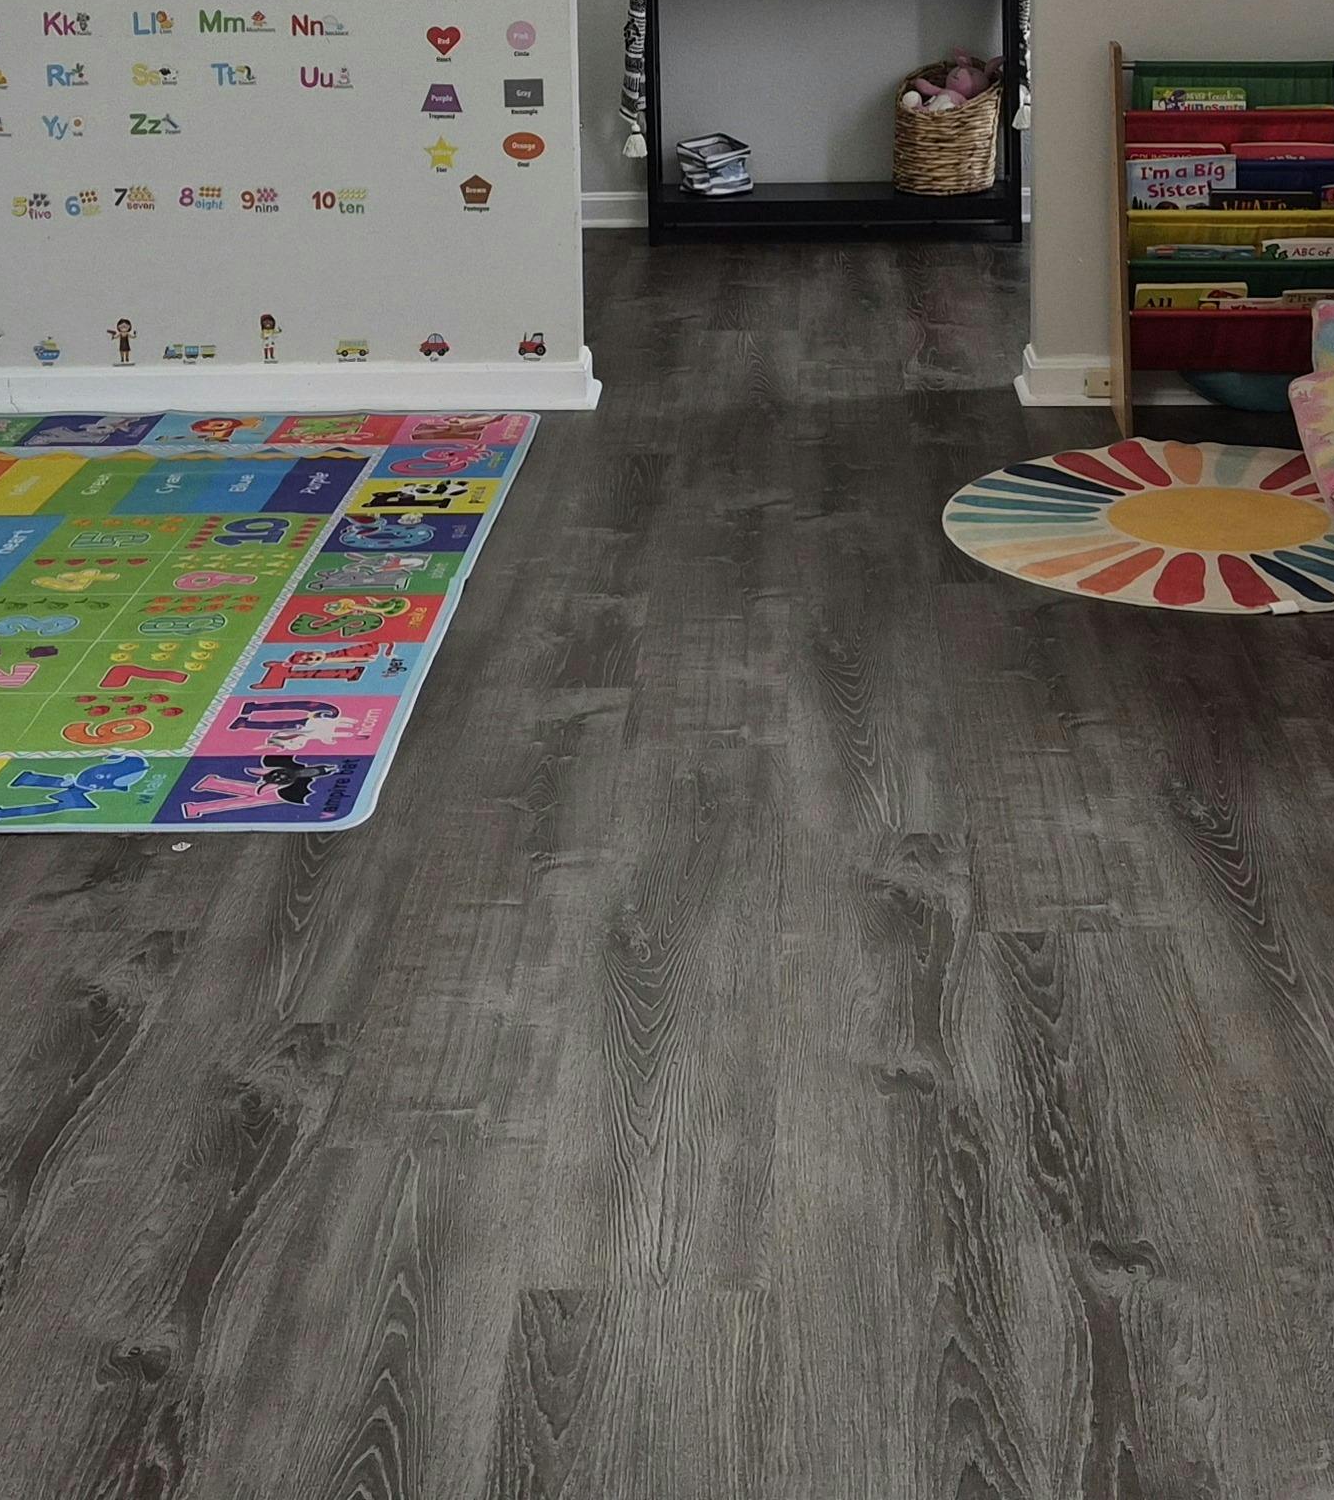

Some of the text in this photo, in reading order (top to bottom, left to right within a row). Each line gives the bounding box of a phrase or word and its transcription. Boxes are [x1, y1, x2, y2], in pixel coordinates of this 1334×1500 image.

[199, 9, 245, 33] Mm
[1141, 163, 1225, 182] I'm a Big
[311, 190, 365, 215] 10 ten
[1292, 247, 1315, 257] ABC
[1318, 247, 1332, 257] of
